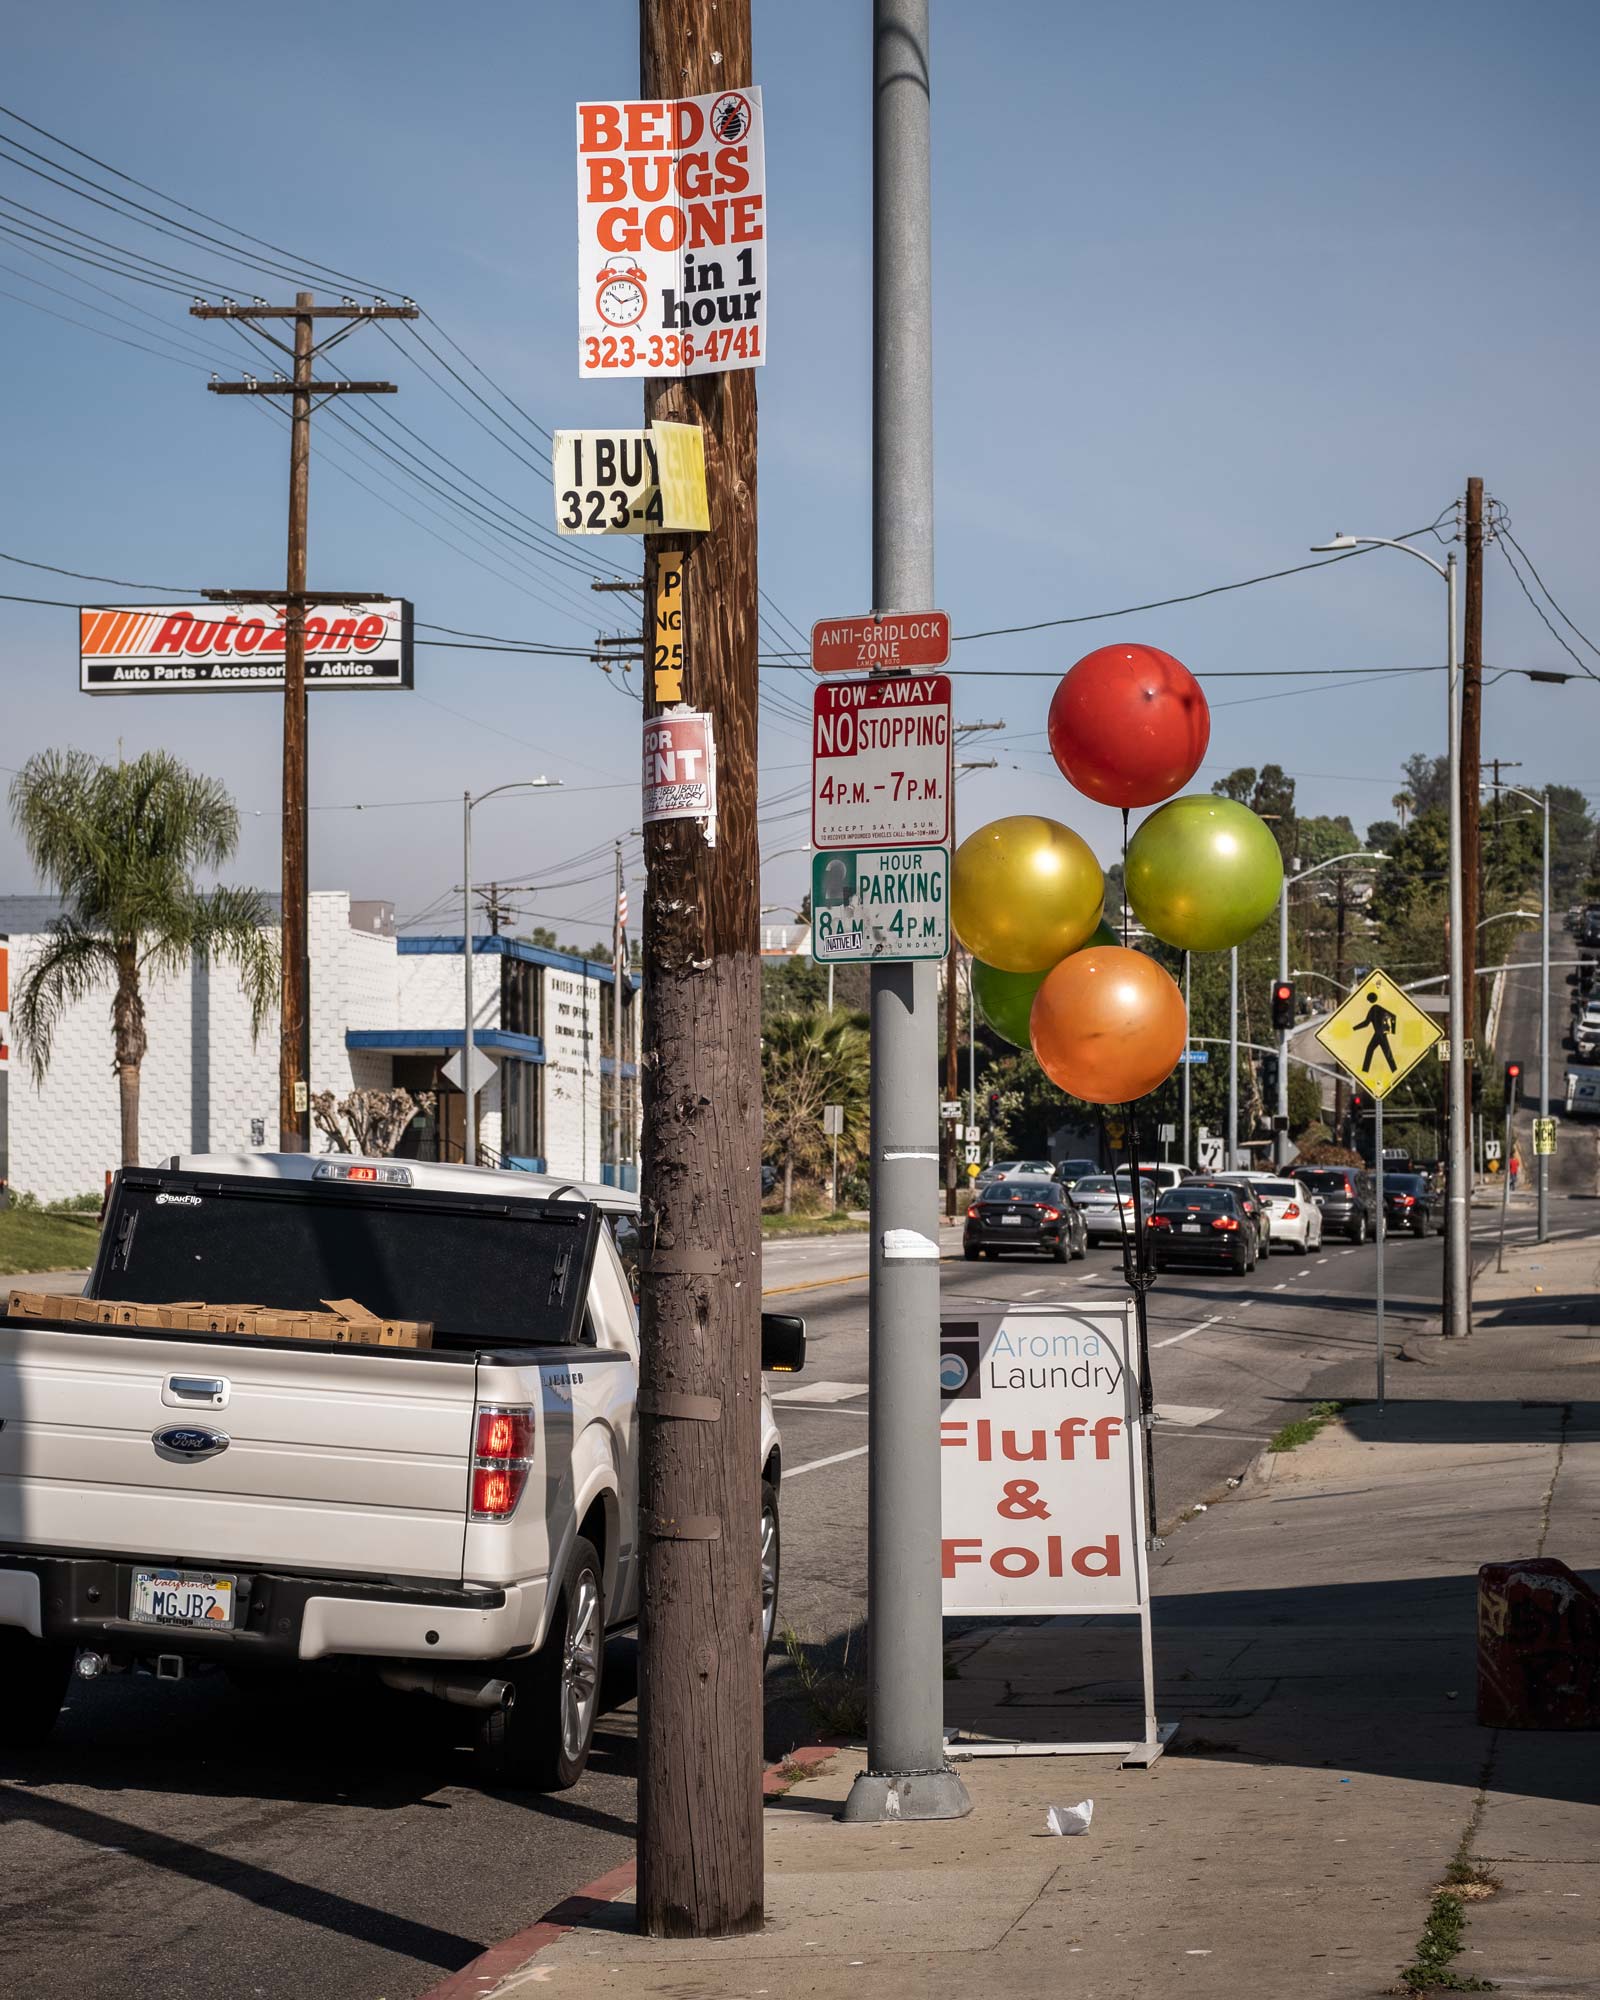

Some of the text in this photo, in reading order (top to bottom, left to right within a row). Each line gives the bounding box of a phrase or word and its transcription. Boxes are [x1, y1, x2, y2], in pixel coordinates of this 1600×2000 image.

[579, 101, 704, 152] BED
[586, 146, 750, 203] BUGS
[596, 194, 763, 252] GONE
[684, 248, 756, 294] in 1
[662, 289, 761, 329] hour
[585, 325, 760, 369] 323-336-4741
[574, 439, 583, 487] I
[149, 609, 385, 656] AutoZone
[820, 622, 940, 646] ANTI-GRIDLOCK
[857, 642, 899, 660] ZONE
[113, 662, 374, 681] Auto Parts Accessori Advice
[828, 681, 937, 708] TOW-AWAY
[645, 730, 673, 753] FOR
[817, 712, 946, 755] NO STOPPING
[643, 749, 702, 786] ENT
[823, 825, 864, 833] EXCEPT
[880, 854, 922, 871] HOUR
[860, 872, 941, 905] PARKING
[827, 937, 851, 951] NATIVE
[992, 1330, 1101, 1358] Aroma
[991, 1360, 1124, 1395] Laundry
[171, 1431, 204, 1449] Ford
[997, 1479, 1052, 1520] &
[941, 1534, 1121, 1578] Fold
[152, 1590, 217, 1619] MGJB2
[156, 1614, 193, 1626] Springs
